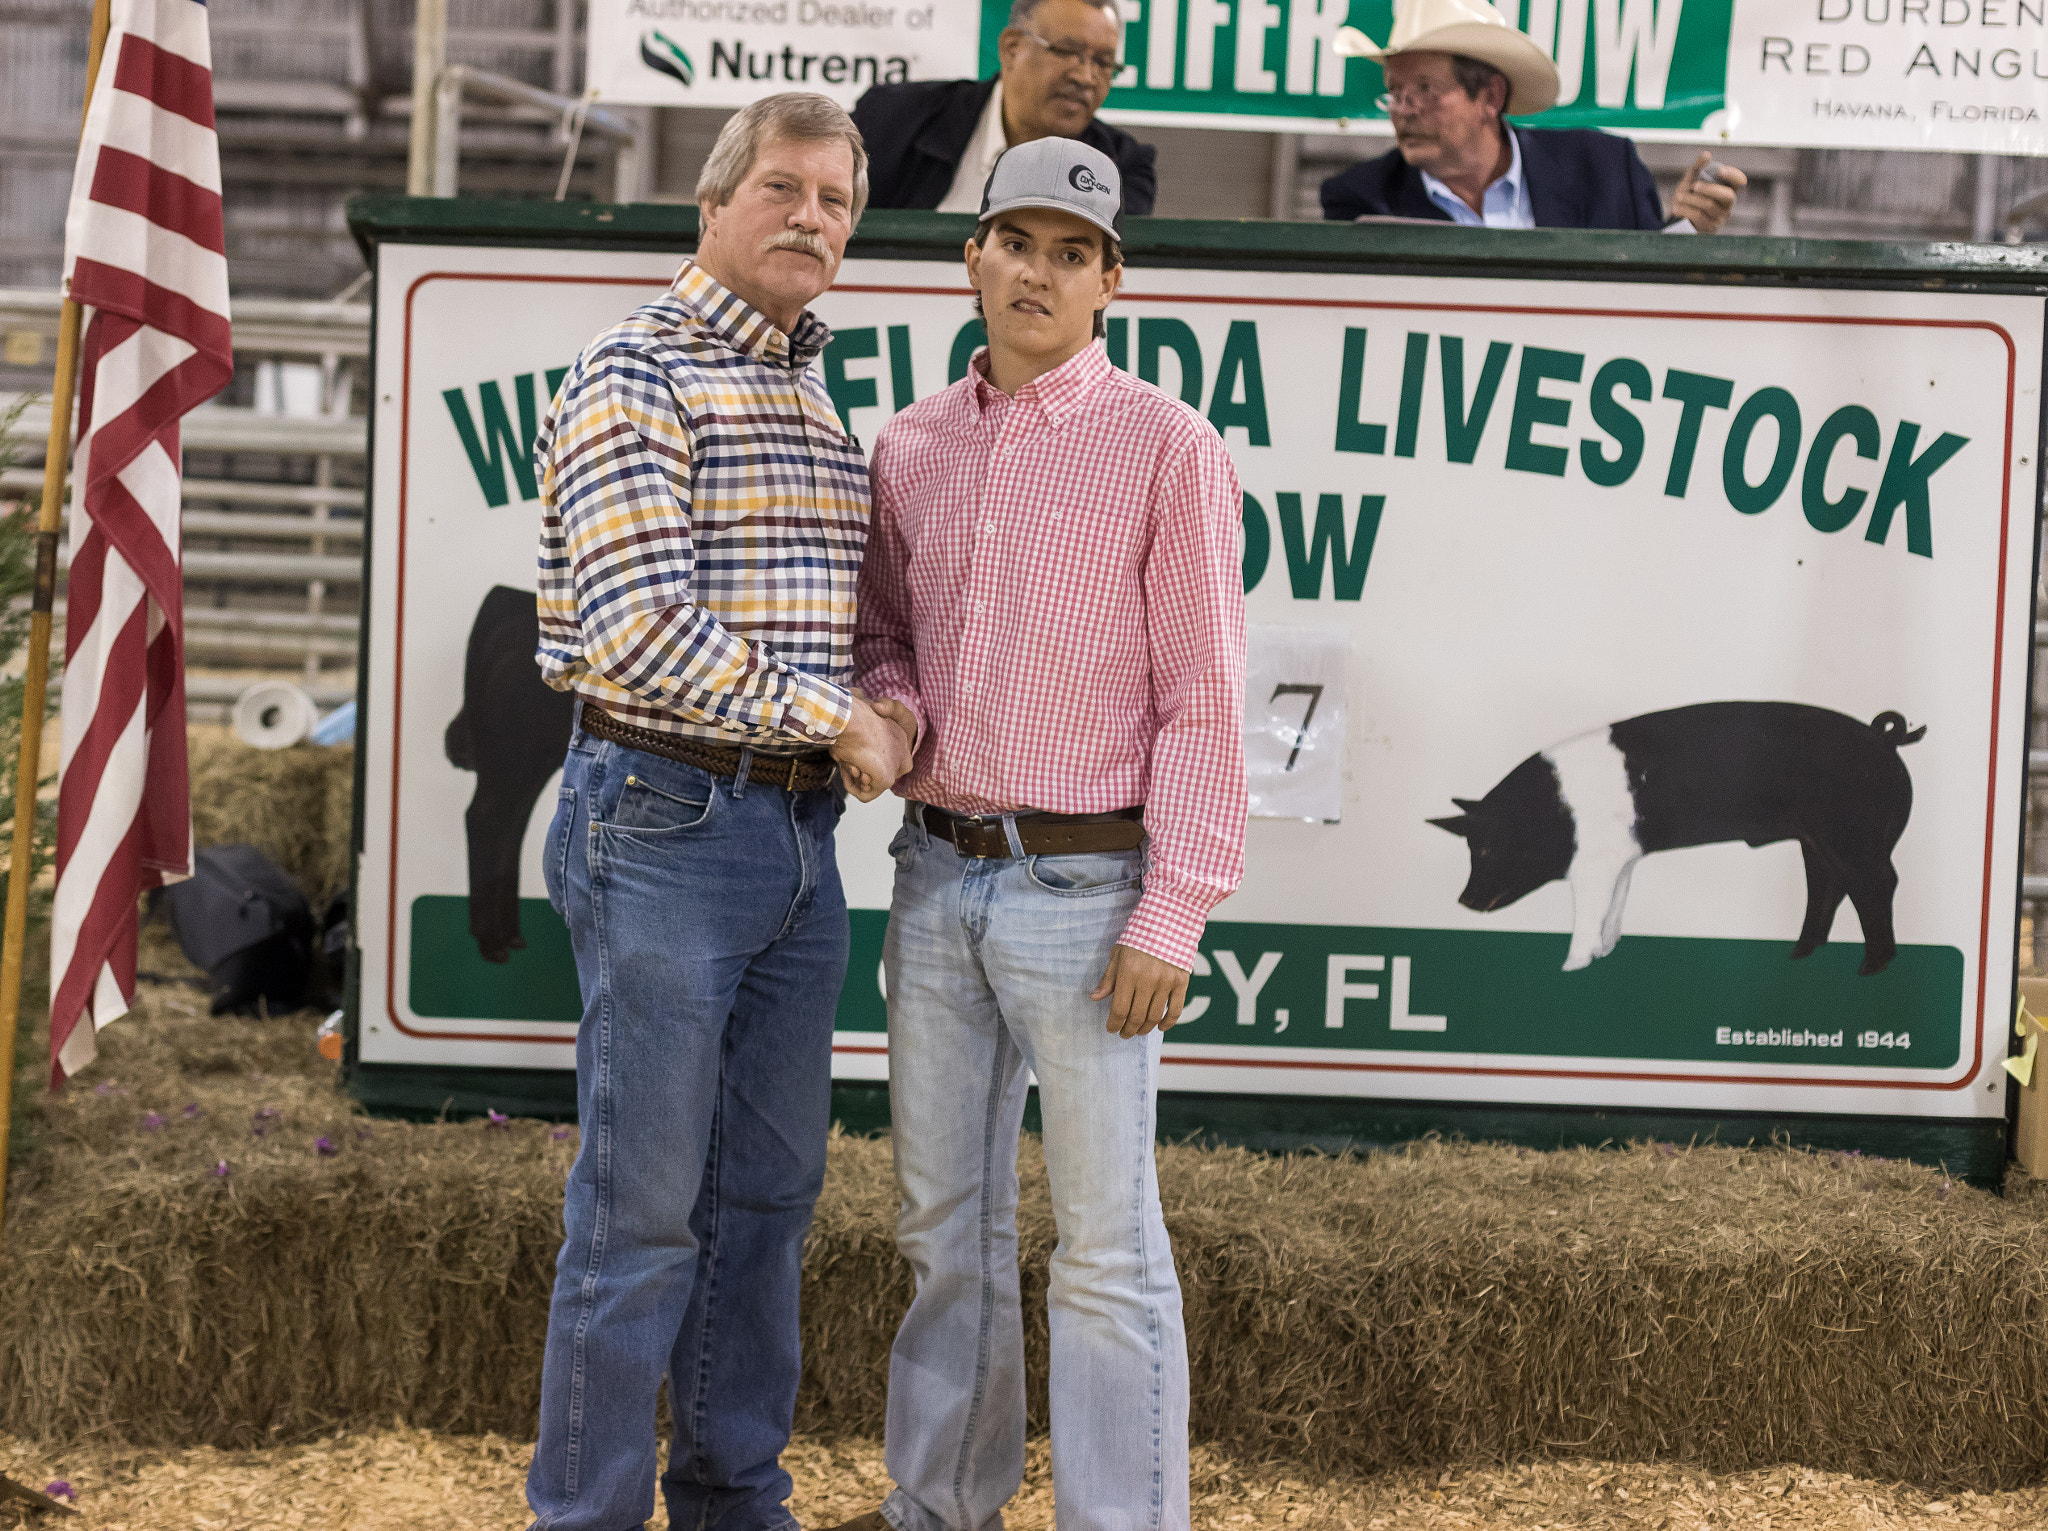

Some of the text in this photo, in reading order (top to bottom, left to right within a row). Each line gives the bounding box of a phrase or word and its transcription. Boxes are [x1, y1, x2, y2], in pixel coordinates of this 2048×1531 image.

[626, 0, 935, 30] Authorized Dealer of
[710, 39, 910, 84] Nutrena
[1761, 36, 1872, 74] RED
[1334, 325, 1972, 560] LIVESTOCK
[1268, 682, 1325, 772] 7
[1324, 953, 1448, 1032] FL
[1715, 1026, 1912, 1049] Established 1944
